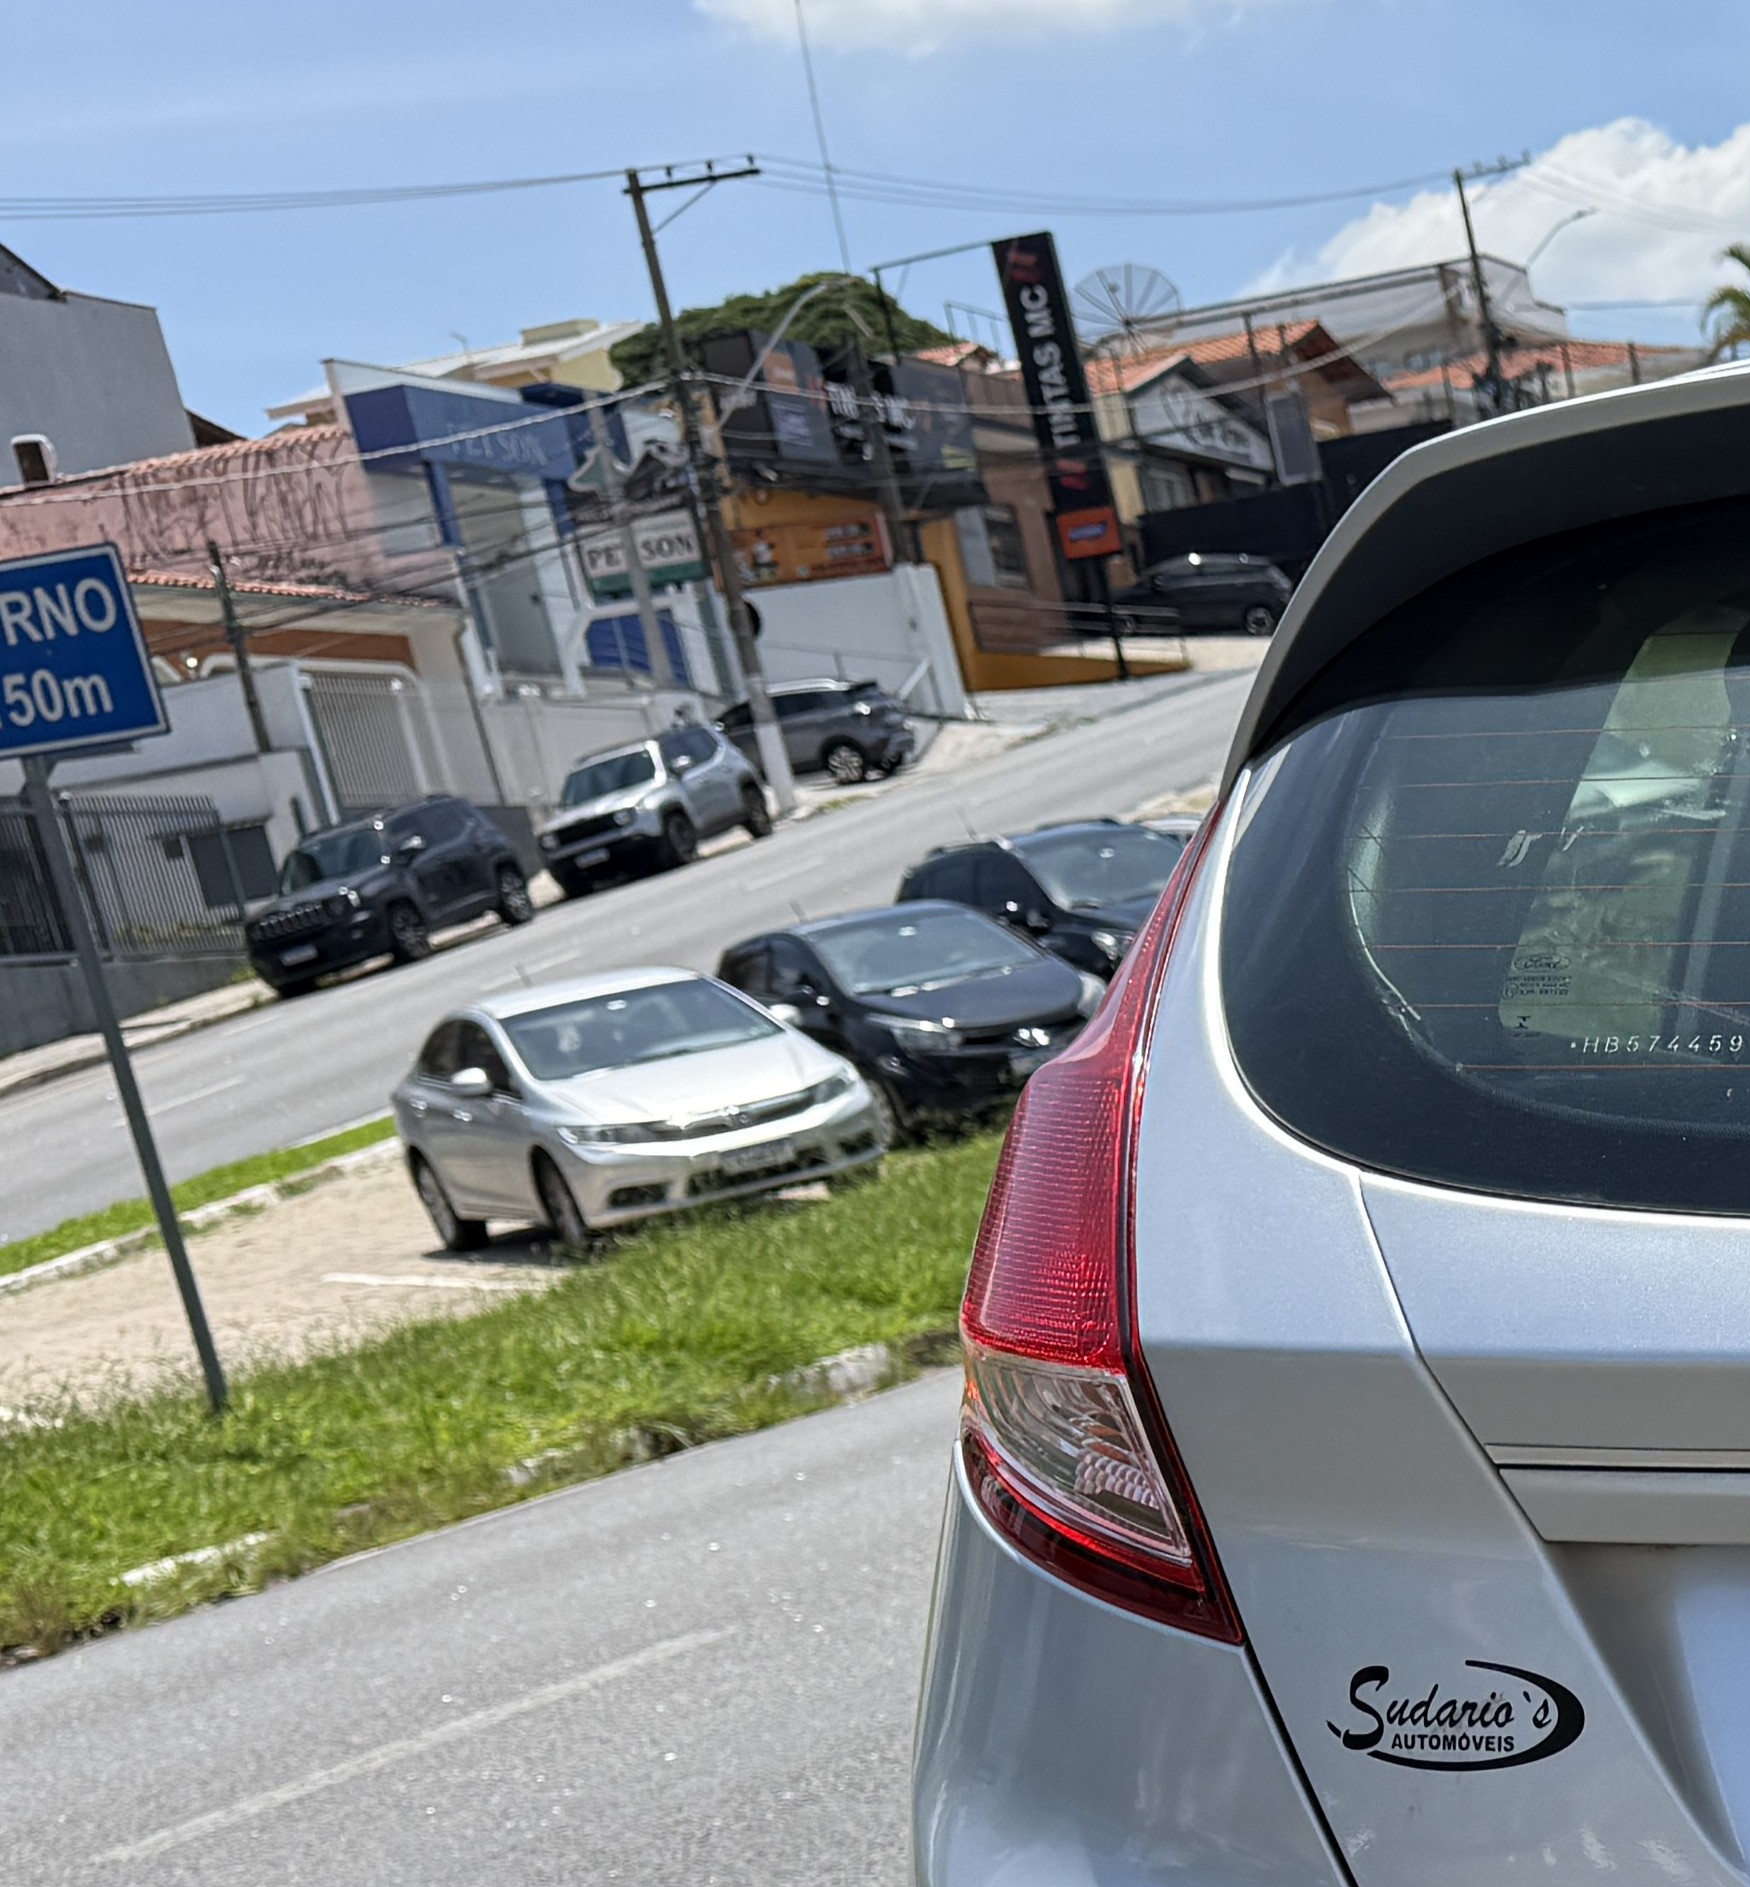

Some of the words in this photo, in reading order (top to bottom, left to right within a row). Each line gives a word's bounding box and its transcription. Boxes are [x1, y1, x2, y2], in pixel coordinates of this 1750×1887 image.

[1019, 284, 1055, 338] MC
[1033, 341, 1081, 449] TINTAS
[639, 534, 693, 561] SON
[1391, 1732, 1515, 1752] AUTOMÓVEIS
